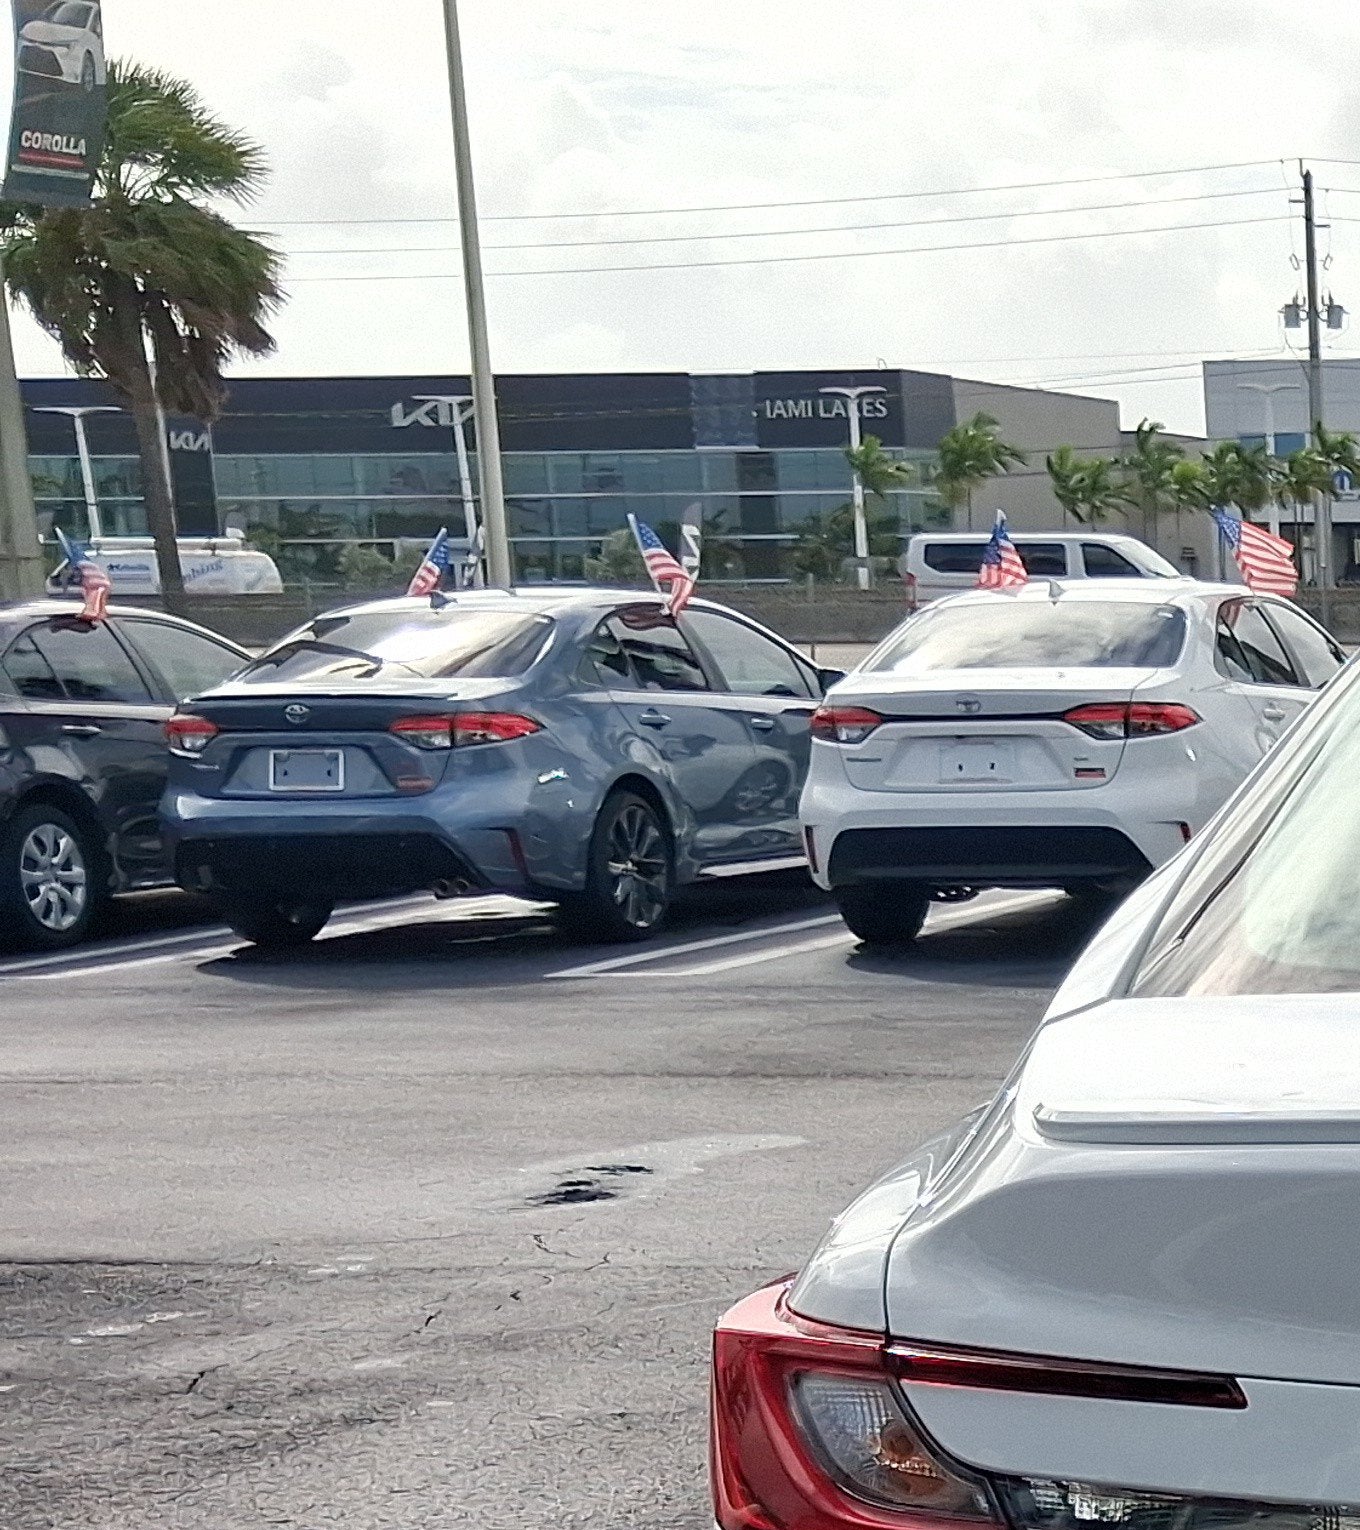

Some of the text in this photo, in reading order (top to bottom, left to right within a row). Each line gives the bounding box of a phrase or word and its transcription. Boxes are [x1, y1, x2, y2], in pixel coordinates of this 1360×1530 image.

[21, 130, 87, 156] COROLLA
[819, 399, 888, 418] LAES
[169, 430, 211, 451] KIA
